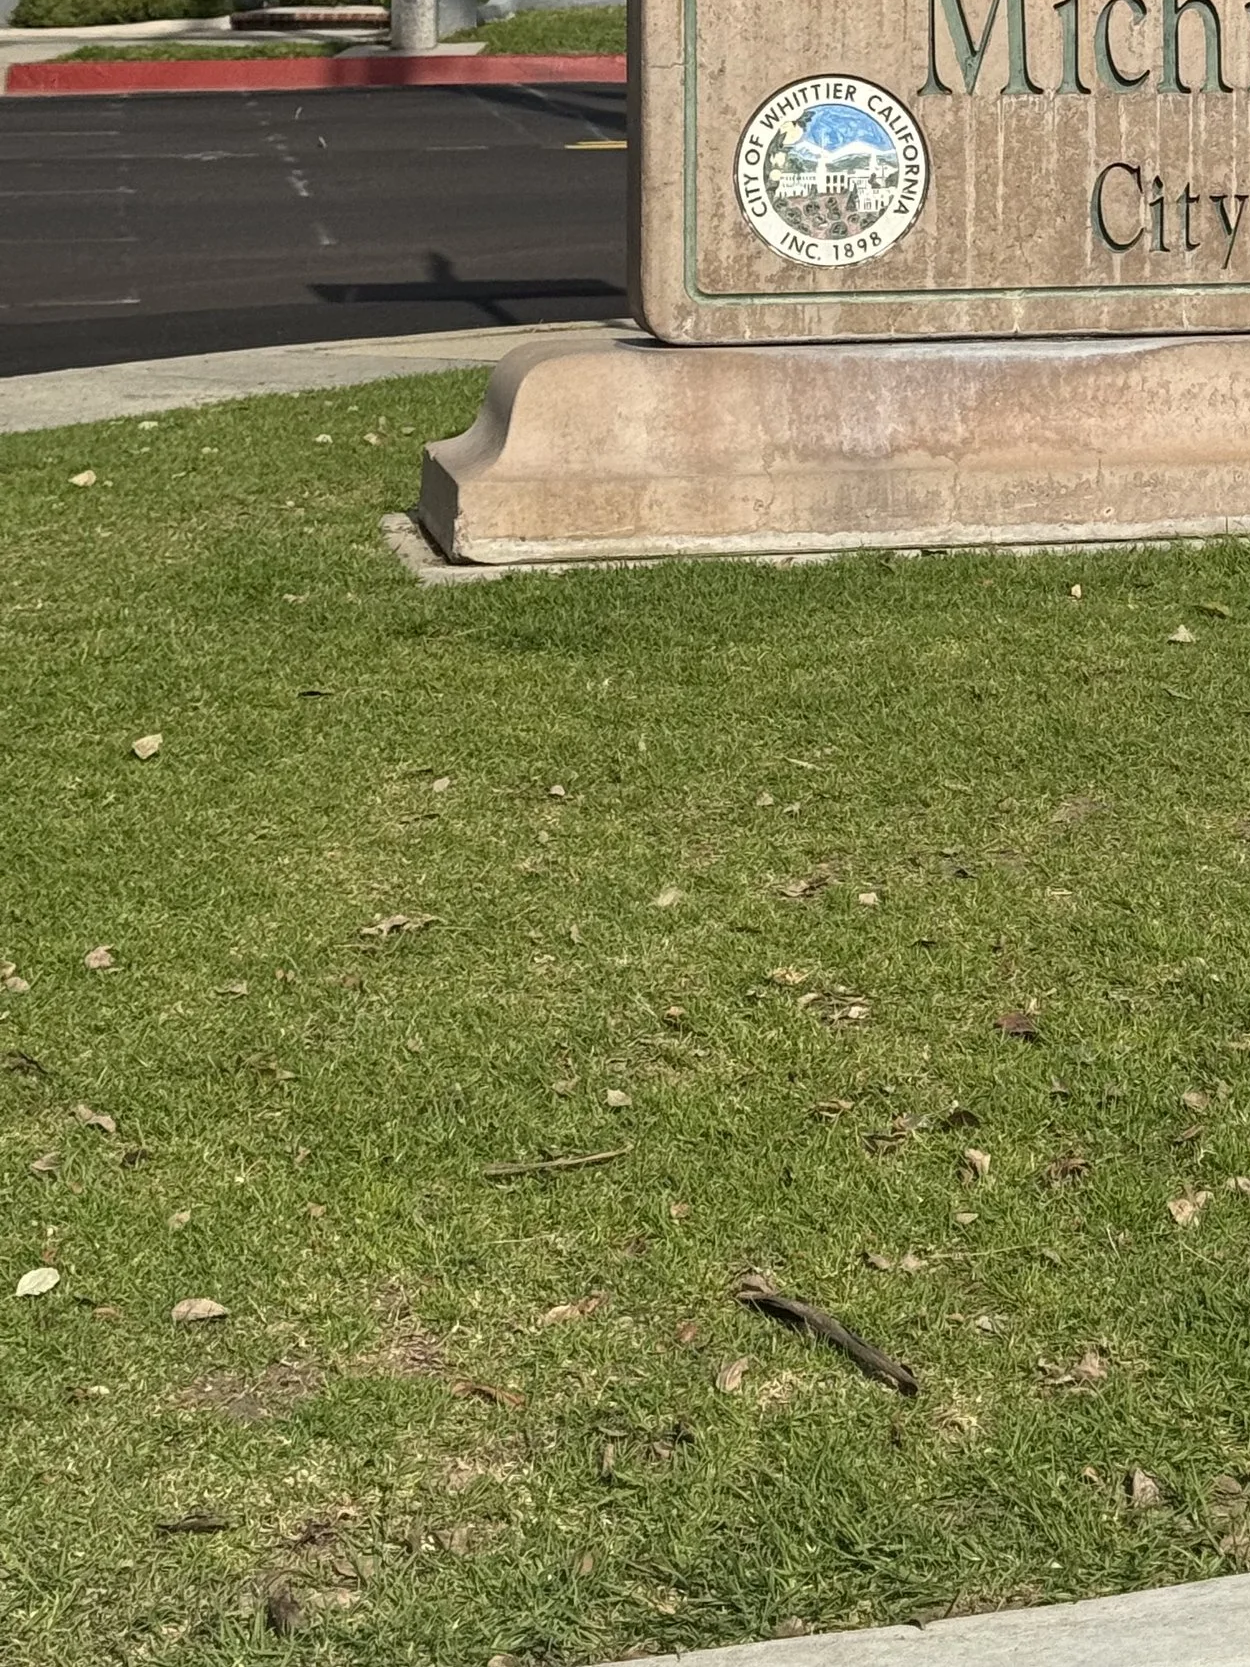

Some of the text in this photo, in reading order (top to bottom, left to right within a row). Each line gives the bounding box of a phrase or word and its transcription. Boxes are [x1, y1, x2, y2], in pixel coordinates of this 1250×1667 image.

[743, 82, 920, 218] CITY OF WHITTIER CALIFORNIA
[780, 231, 882, 261] INC. 1898
